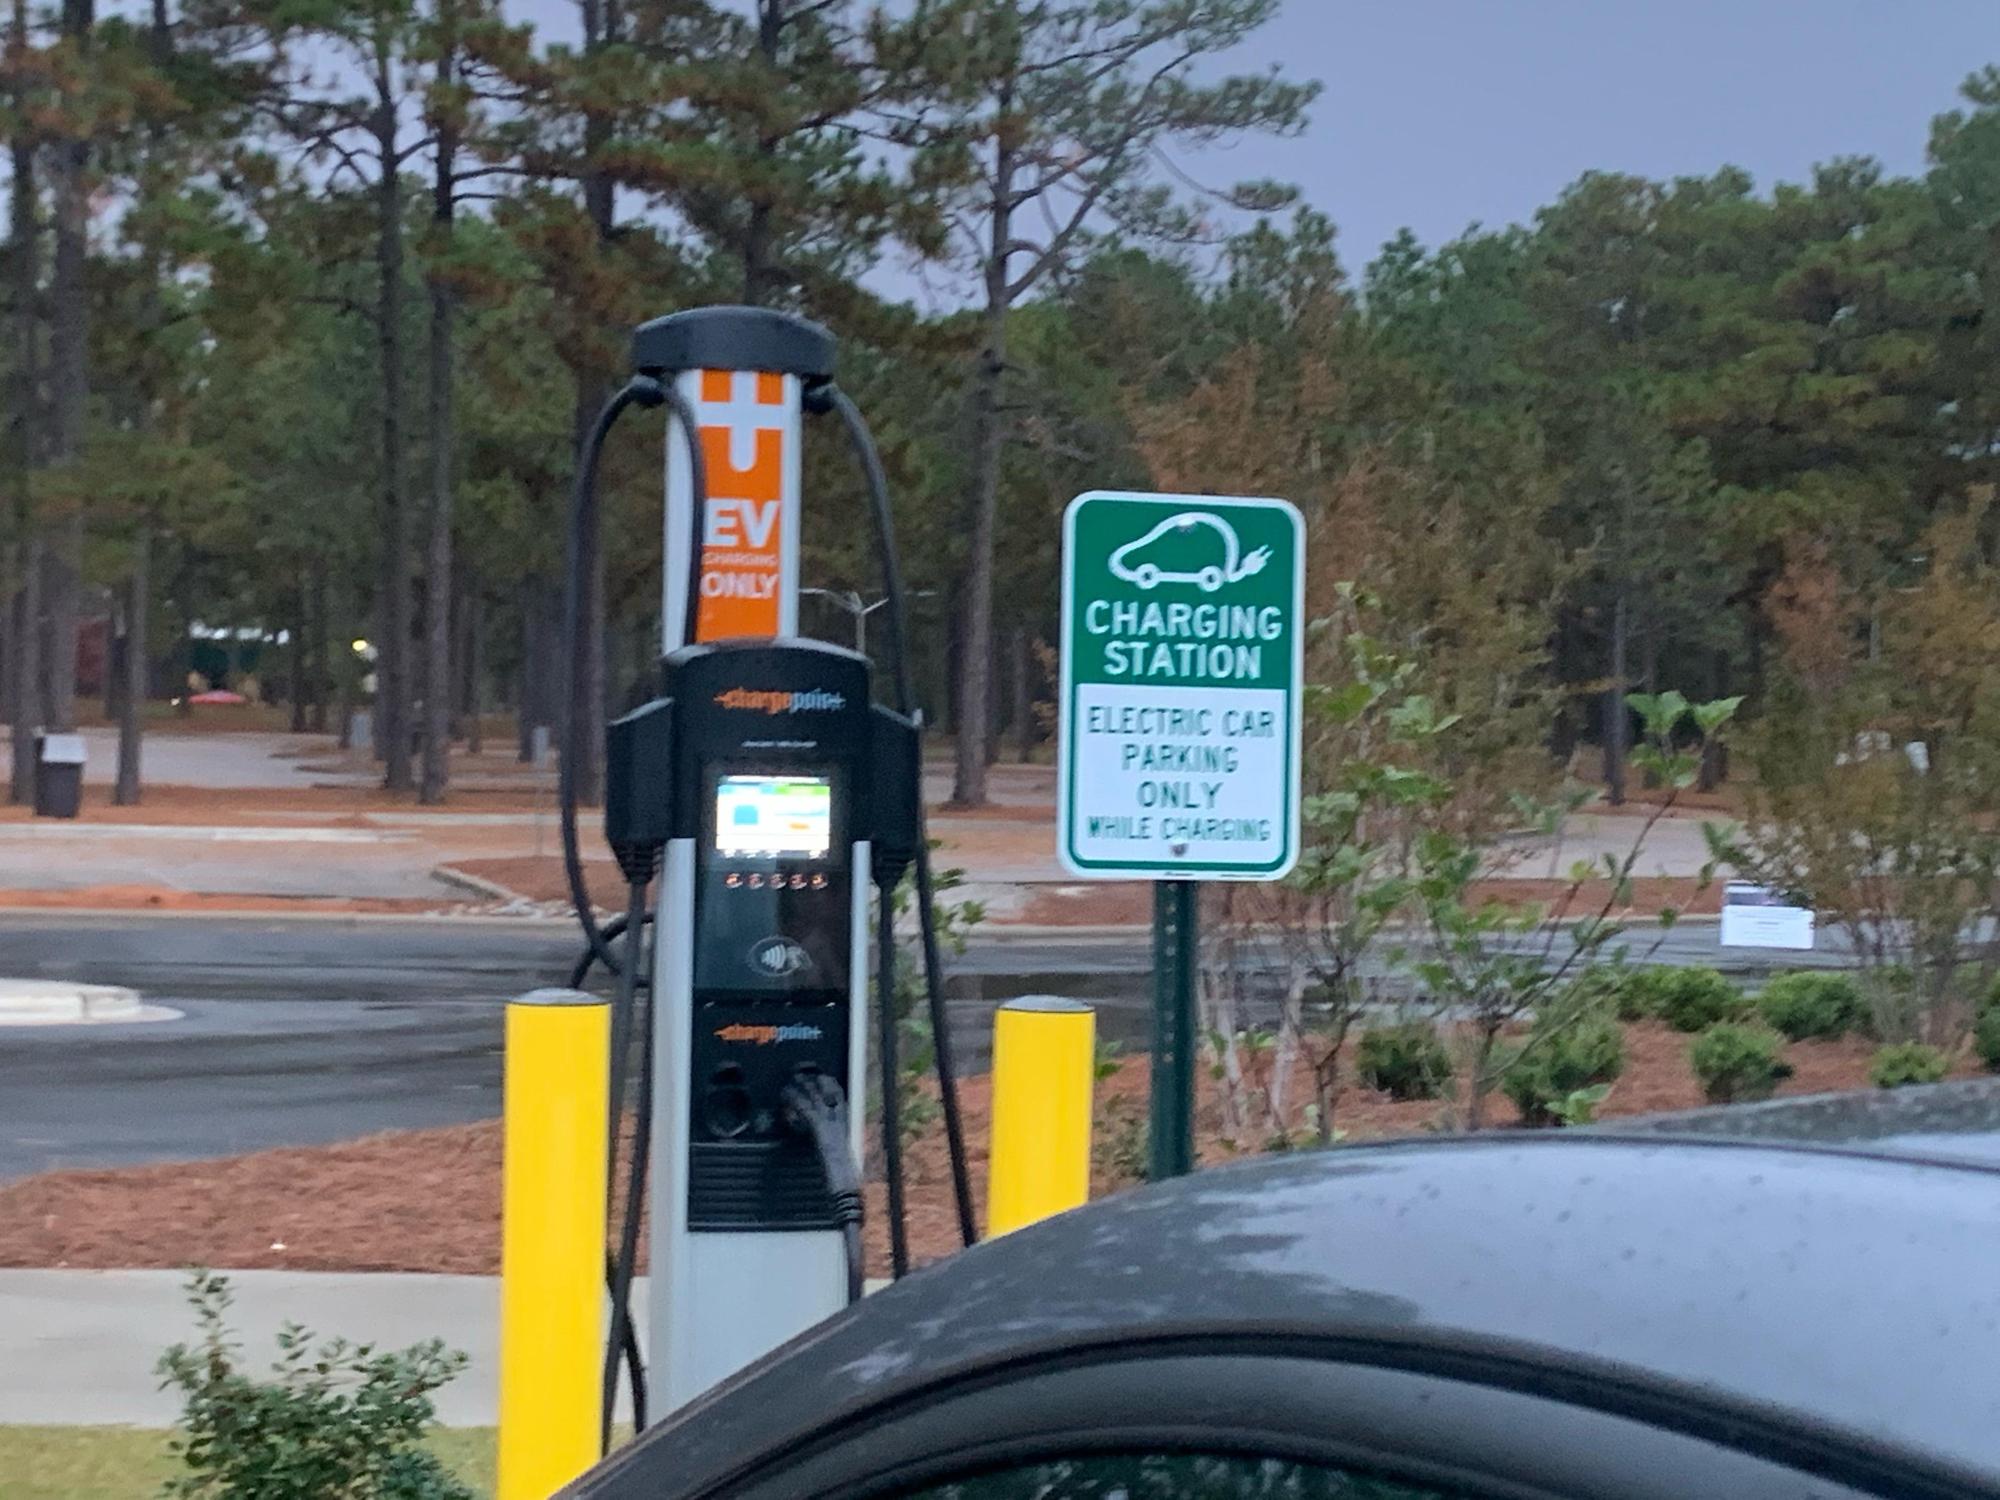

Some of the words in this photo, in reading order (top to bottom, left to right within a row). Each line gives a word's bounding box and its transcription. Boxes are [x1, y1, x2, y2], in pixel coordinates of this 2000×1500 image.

[703, 498, 779, 548] EV
[700, 572, 779, 599] ONLY
[1085, 600, 1283, 641] CHARGING
[1103, 640, 1262, 680] STATION
[1087, 706, 1213, 736] ELECTRIC
[1223, 710, 1276, 738] CAR
[1121, 744, 1240, 773] PARKING
[1137, 781, 1223, 809] ONLY
[1087, 816, 1153, 839] WHILE
[1160, 817, 1272, 842] CHARGING
